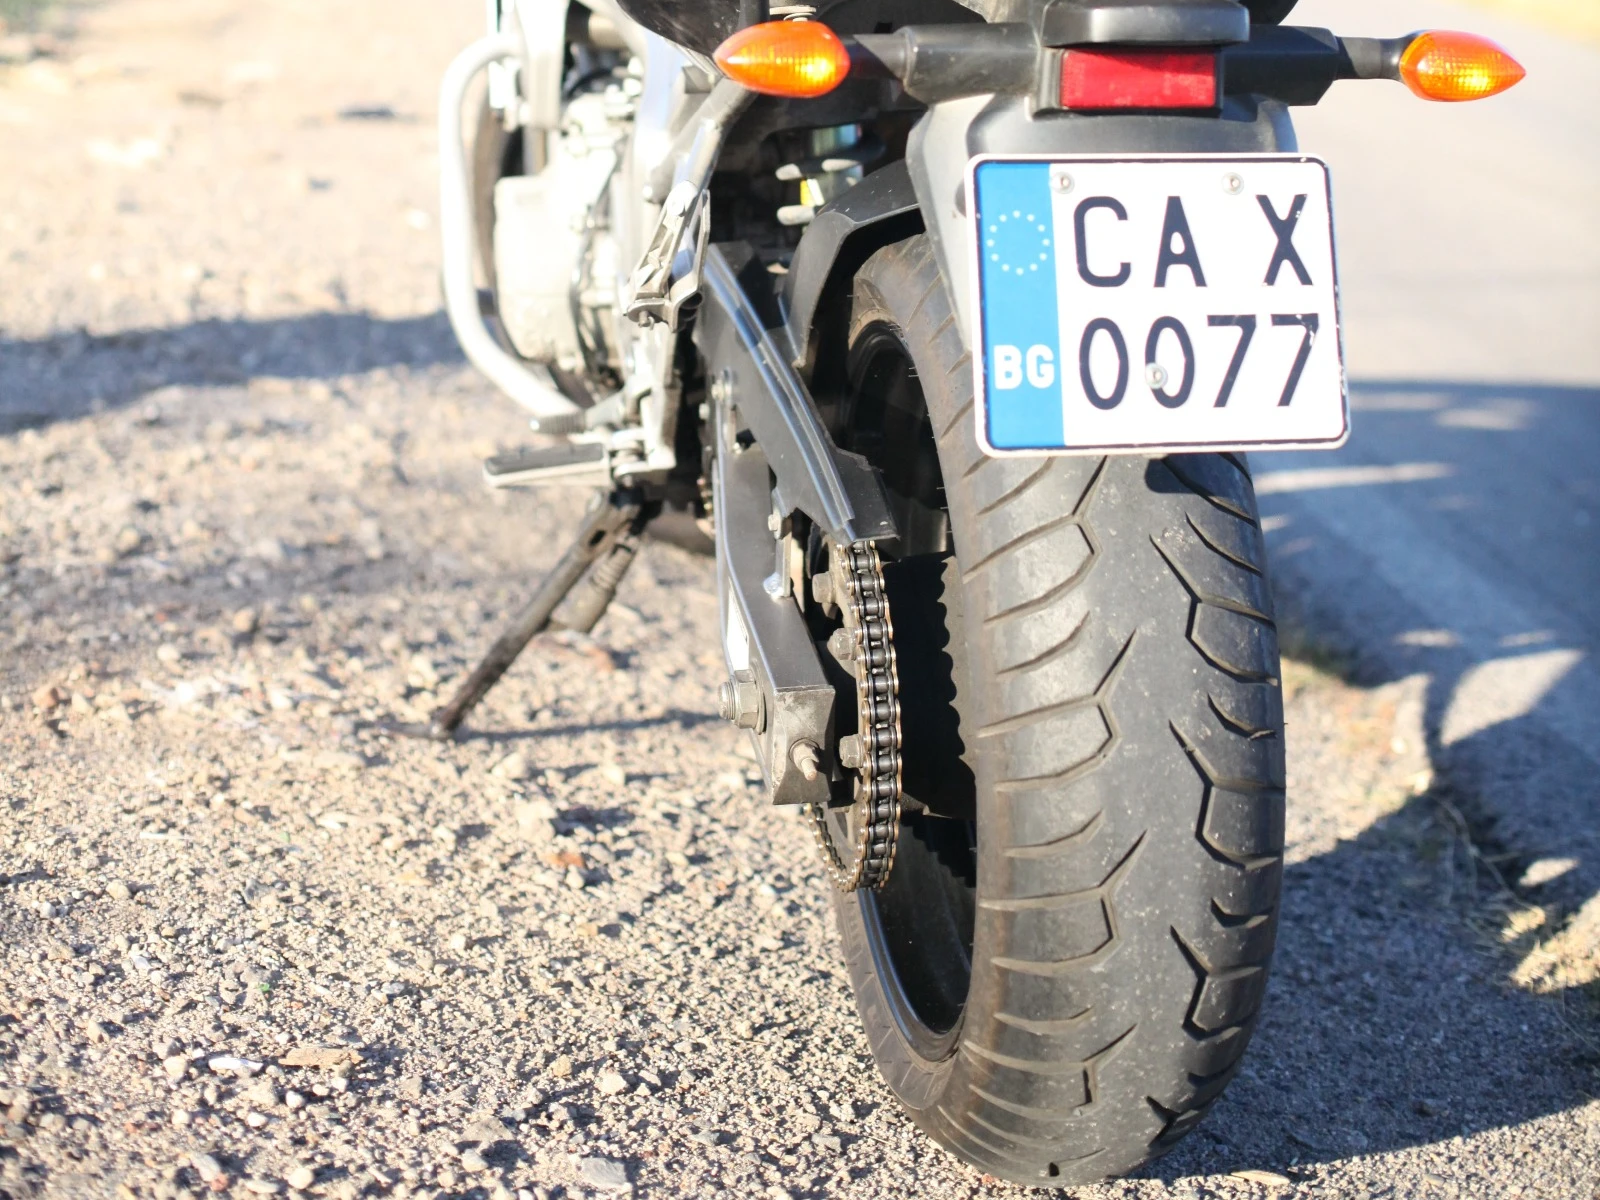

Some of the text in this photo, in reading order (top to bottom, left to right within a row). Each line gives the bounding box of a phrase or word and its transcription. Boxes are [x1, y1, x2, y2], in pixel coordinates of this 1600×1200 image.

[1073, 193, 1313, 288] CA X
[992, 343, 1056, 391] BG
[1078, 312, 1320, 411] 0077
